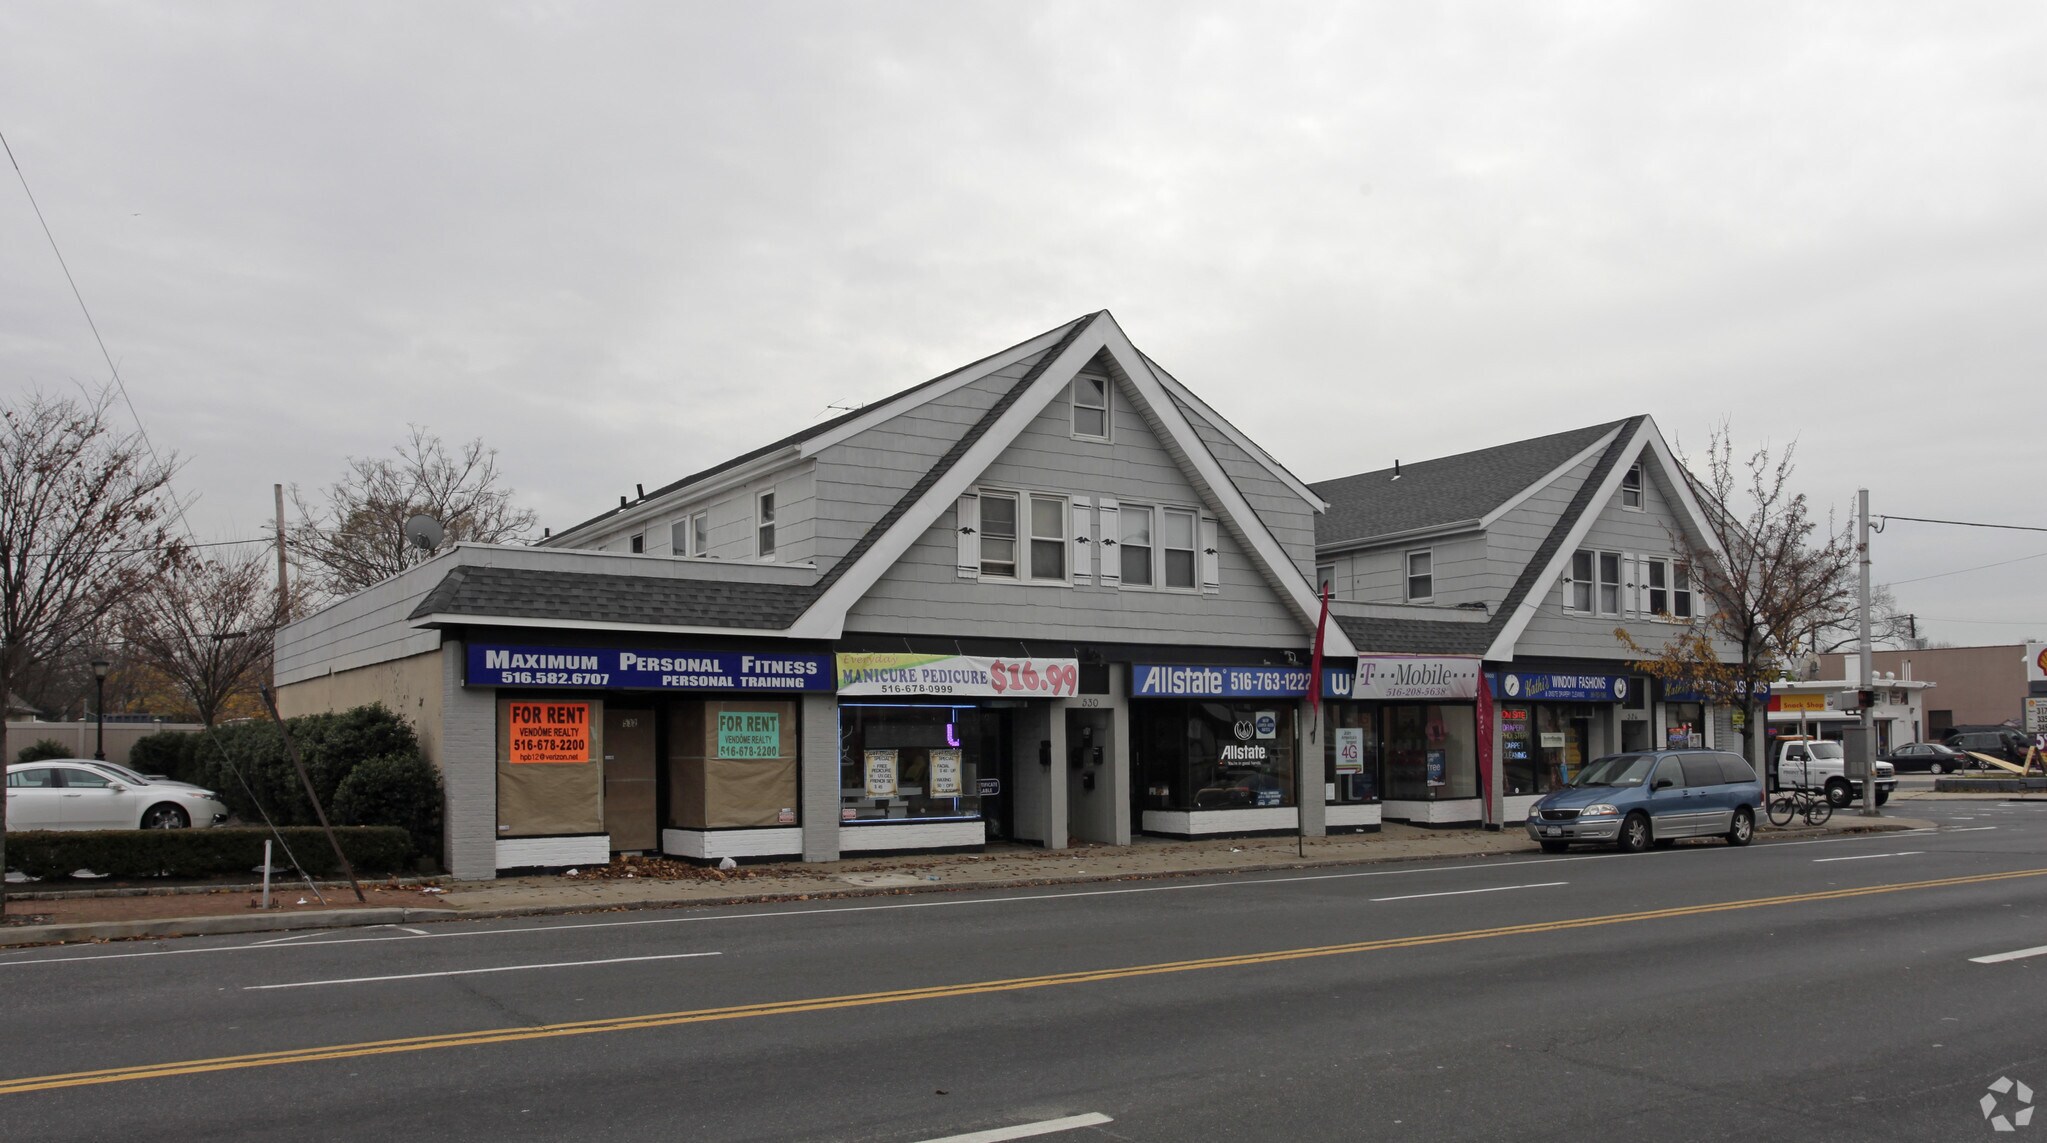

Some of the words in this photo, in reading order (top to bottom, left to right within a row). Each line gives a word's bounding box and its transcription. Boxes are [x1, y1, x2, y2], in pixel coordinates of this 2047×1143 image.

[843, 654, 898, 666] Everyday
[501, 671, 610, 685] 516.582.6707
[662, 674, 735, 687] PERSONAL
[739, 676, 805, 688] TRAINING
[842, 668, 918, 684] MANICURE
[922, 668, 988, 685] PEDICURE
[990, 659, 1077, 697] $16.99
[1141, 666, 1223, 694] Allstate
[1230, 672, 1312, 691] 516-763-1222
[1551, 675, 1577, 689] WINDOW
[1578, 676, 1607, 690] FASHIONS
[881, 684, 953, 694] 516-678-0999
[1385, 687, 1447, 697] 516-208-5638
[1081, 699, 1099, 707] 530
[1806, 701, 1824, 709] Shop
[512, 706, 542, 724] FOR
[547, 706, 585, 724] RENT
[719, 715, 743, 732] FOR
[746, 716, 777, 733] RENT
[553, 727, 579, 737] REALTY
[514, 739, 585, 751] 516-678-2200
[751, 735, 772, 744] REALTY
[720, 746, 777, 757] 516-678-2200
[1221, 745, 1266, 760] Allstate
[1341, 745, 1358, 759] 4G
[1427, 762, 1441, 772] free
